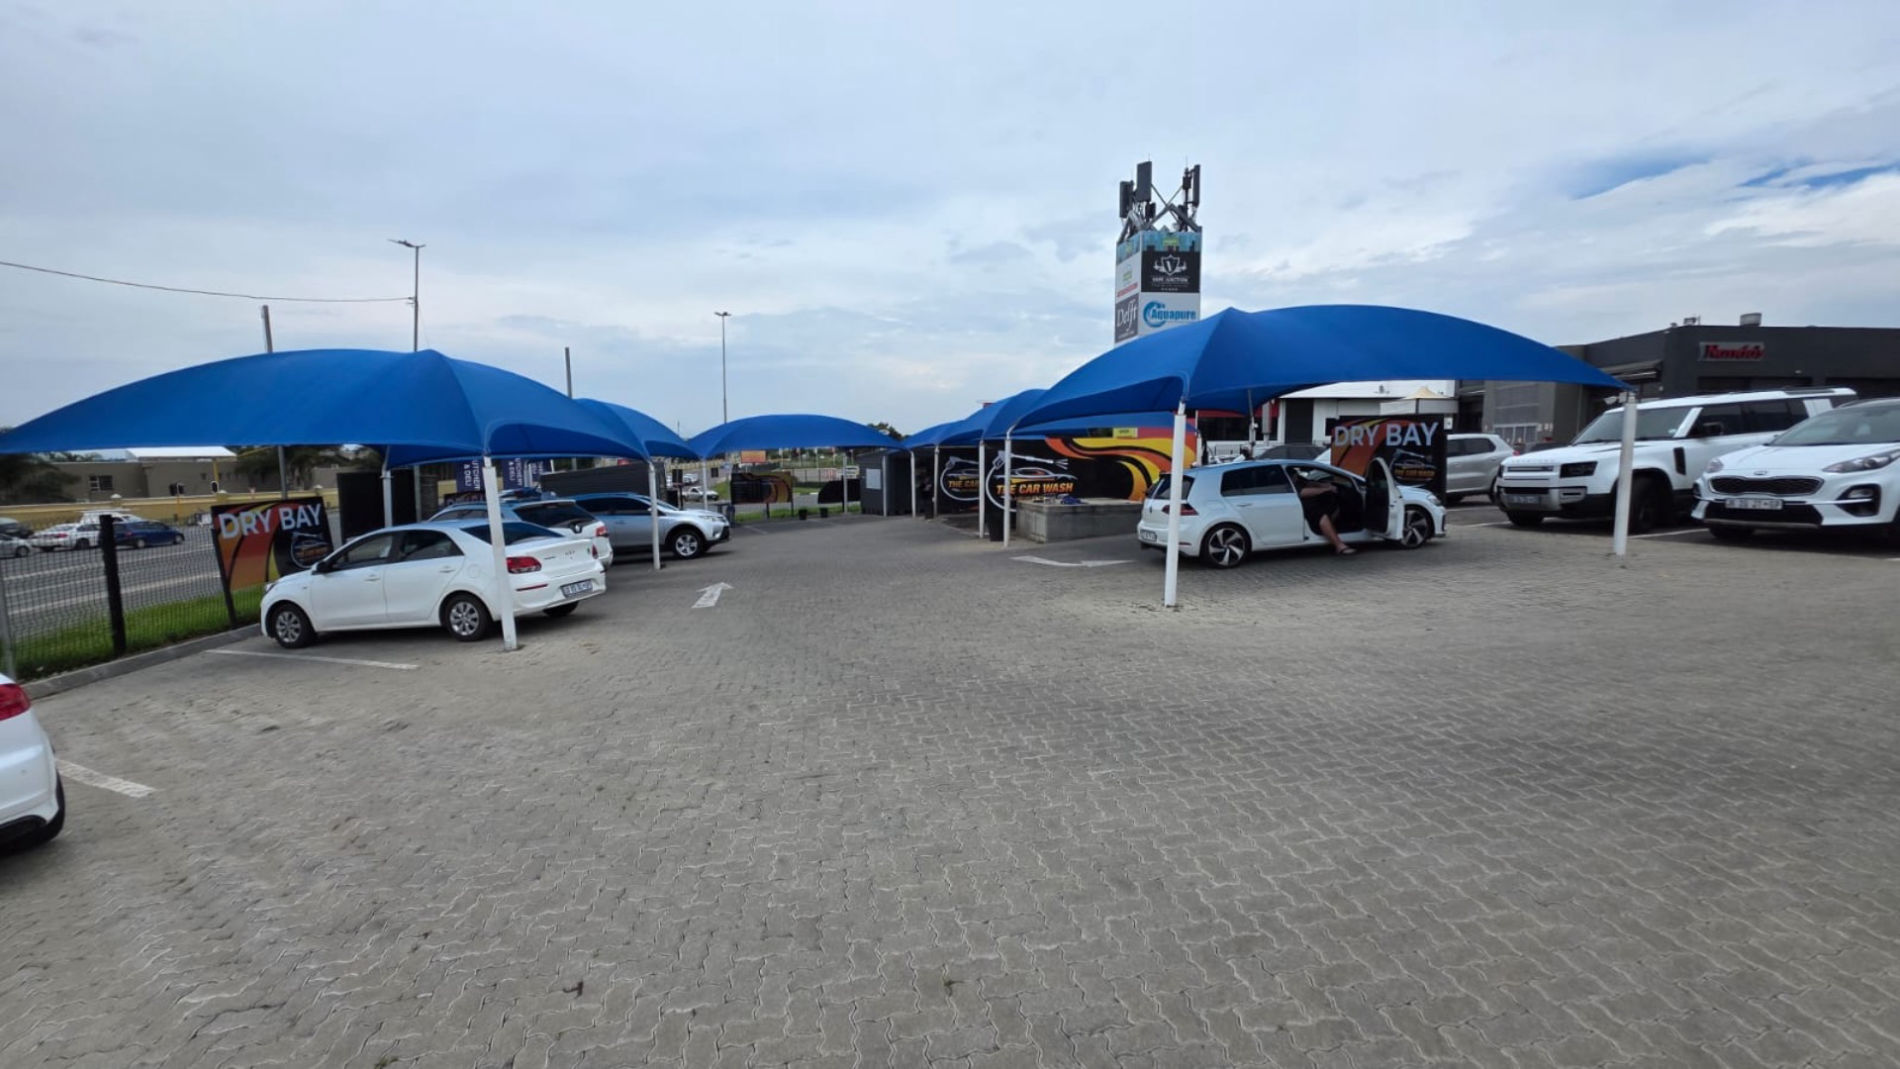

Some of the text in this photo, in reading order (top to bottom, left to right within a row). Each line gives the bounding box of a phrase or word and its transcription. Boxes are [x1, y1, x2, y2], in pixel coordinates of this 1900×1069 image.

[1151, 308, 1197, 321] Aquapure
[1334, 422, 1439, 447] DRY BAY
[996, 482, 1074, 495] TE CAR WASH
[218, 503, 322, 539] DRY BAY
